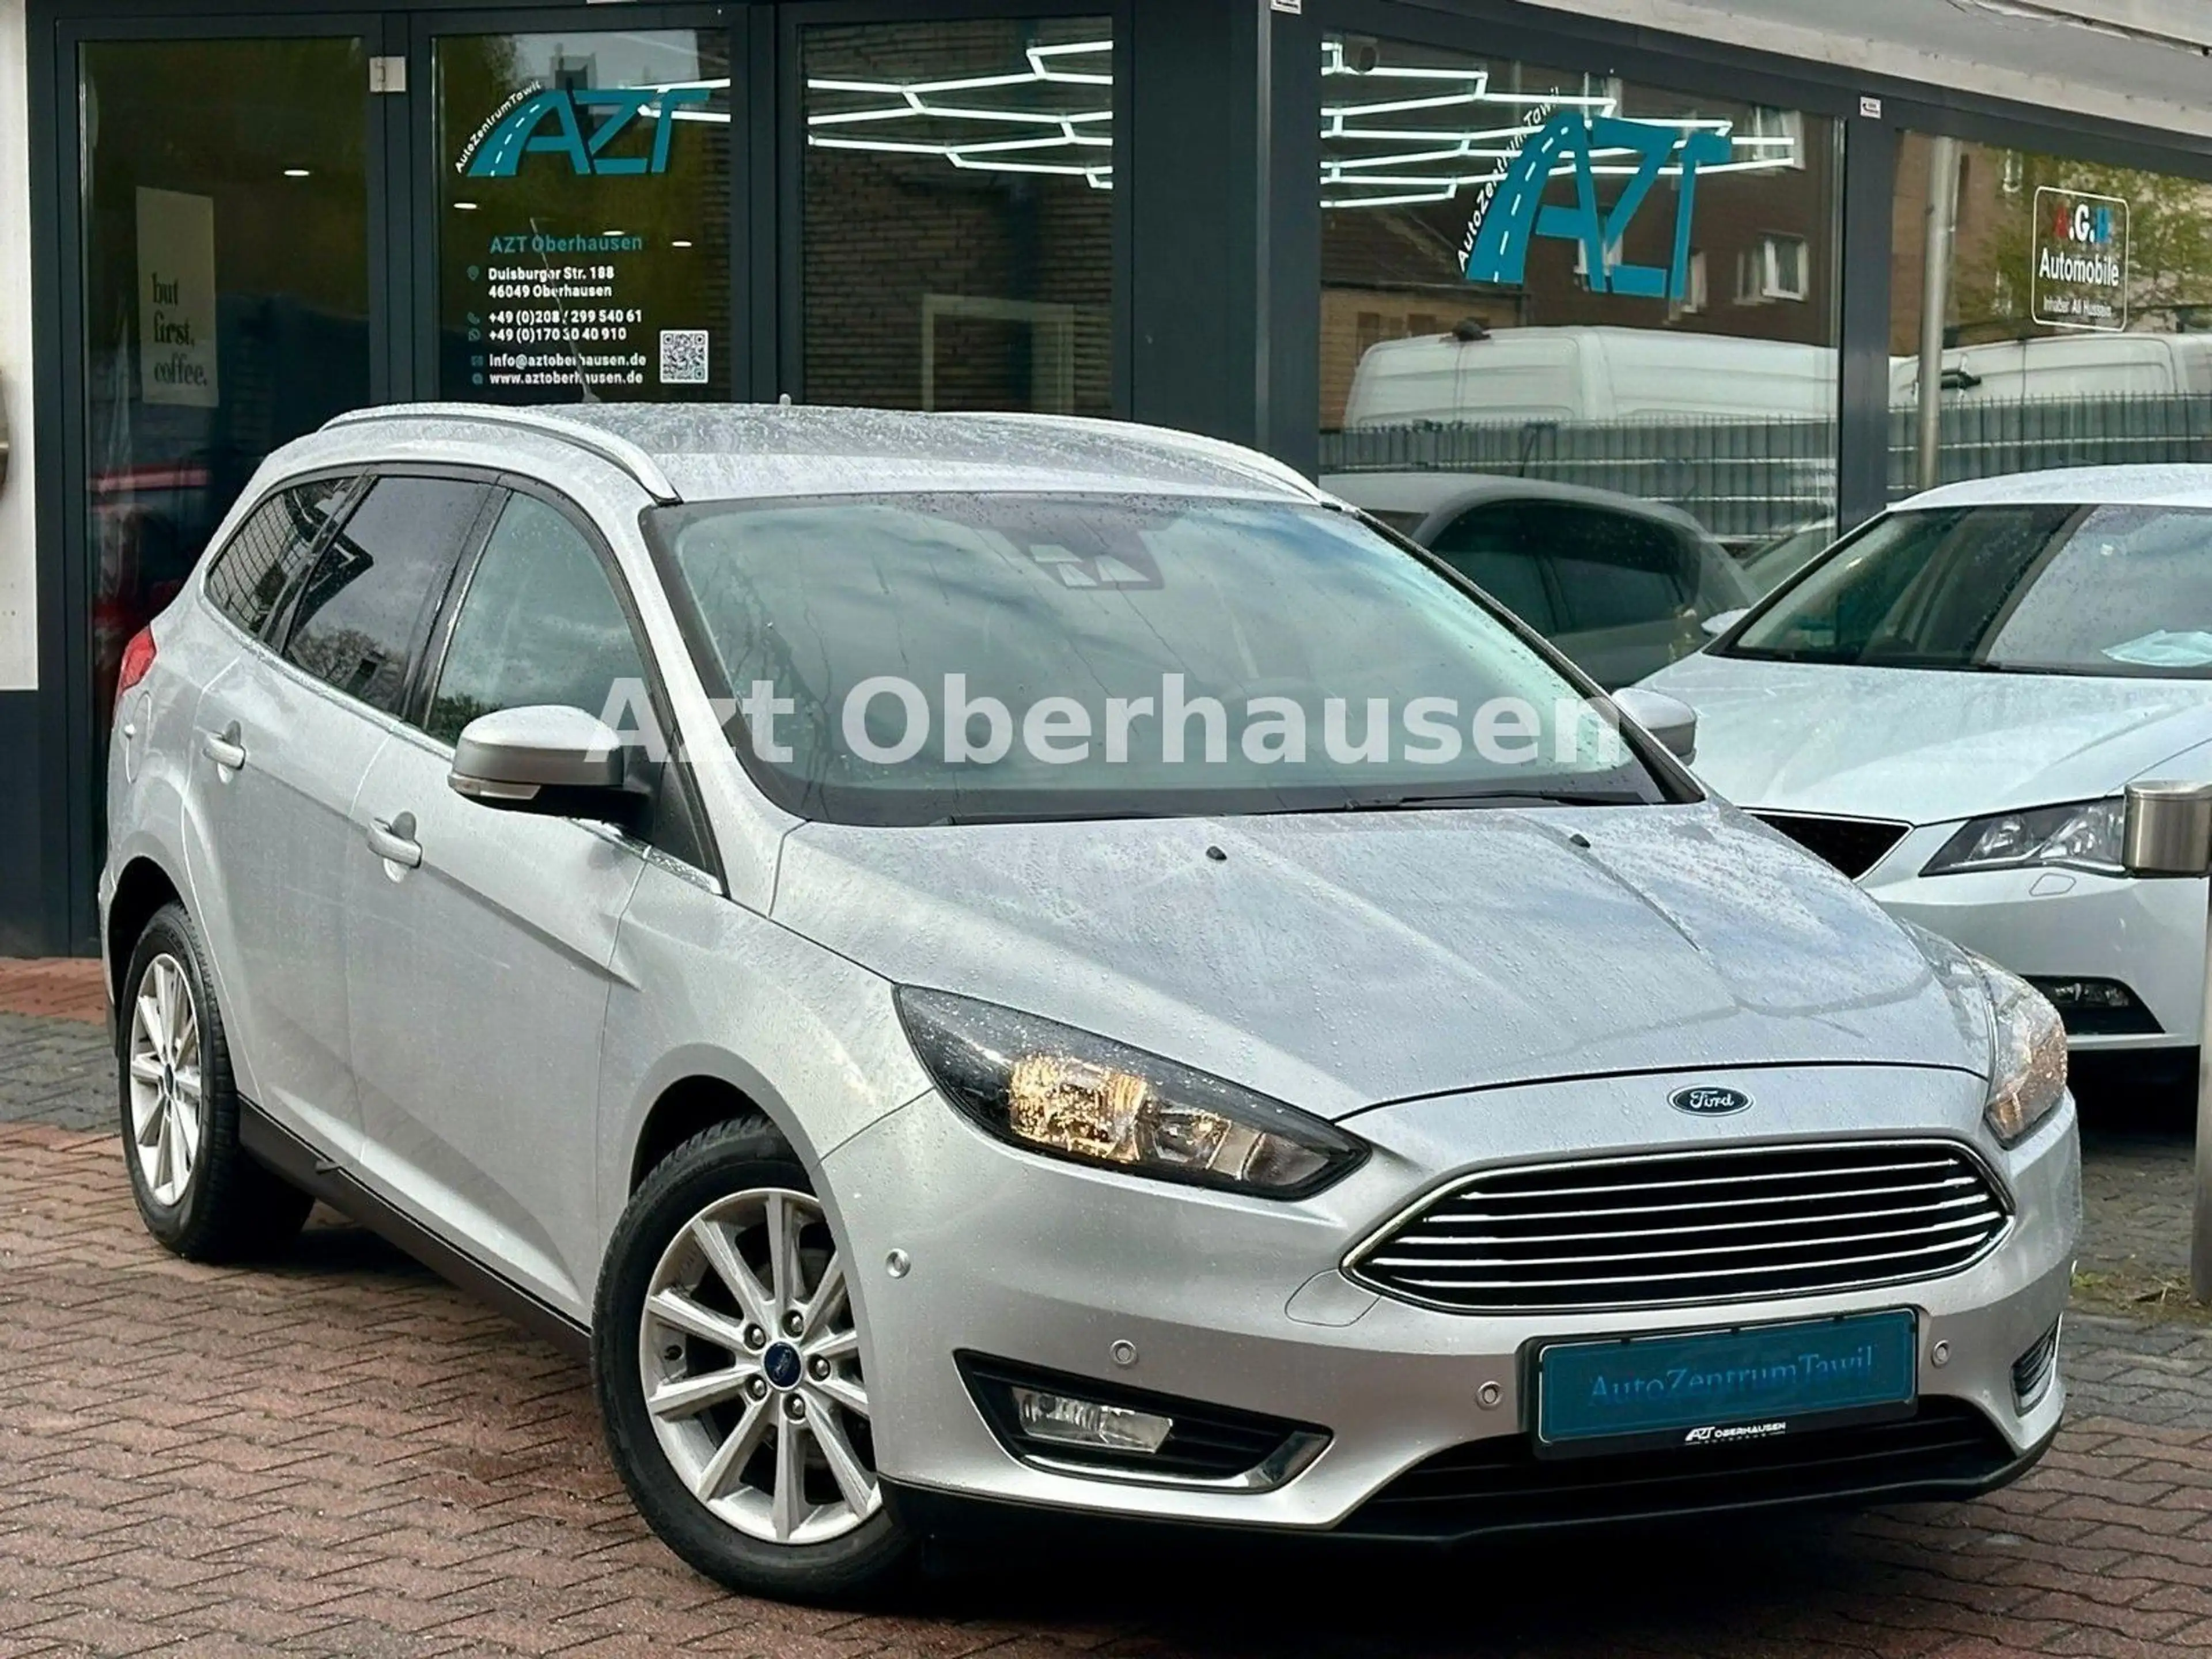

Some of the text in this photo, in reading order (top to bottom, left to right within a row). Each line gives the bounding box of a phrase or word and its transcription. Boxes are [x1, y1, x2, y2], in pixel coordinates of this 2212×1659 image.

[454, 80, 541, 173] AutoZentrumTawil
[467, 89, 710, 177] AZT
[1465, 111, 1732, 300] AZT
[490, 234, 642, 253] AZT Oberhausen
[488, 266, 615, 282] Duisburger Str. 188
[2039, 247, 2120, 287] Automobile
[152, 272, 179, 308] but
[488, 283, 612, 298] 46049 Oberhausen
[154, 310, 195, 348] first,
[490, 310, 513, 324] +49
[516, 310, 560, 325] (0)208
[571, 309, 596, 323] 299
[599, 309, 624, 323] 540
[626, 309, 642, 323] 61
[490, 328, 513, 341] +49
[516, 327, 560, 343] (0)170
[582, 327, 599, 340] 40
[601, 327, 627, 340] 910
[154, 353, 208, 387] coffee.
[1690, 1090, 1734, 1108] Ford
[1588, 1346, 1872, 1407] AutoZentrumTawil
[1685, 1426, 1715, 1442] AZT
[1714, 1422, 1786, 1438] OBERHAUSEN
